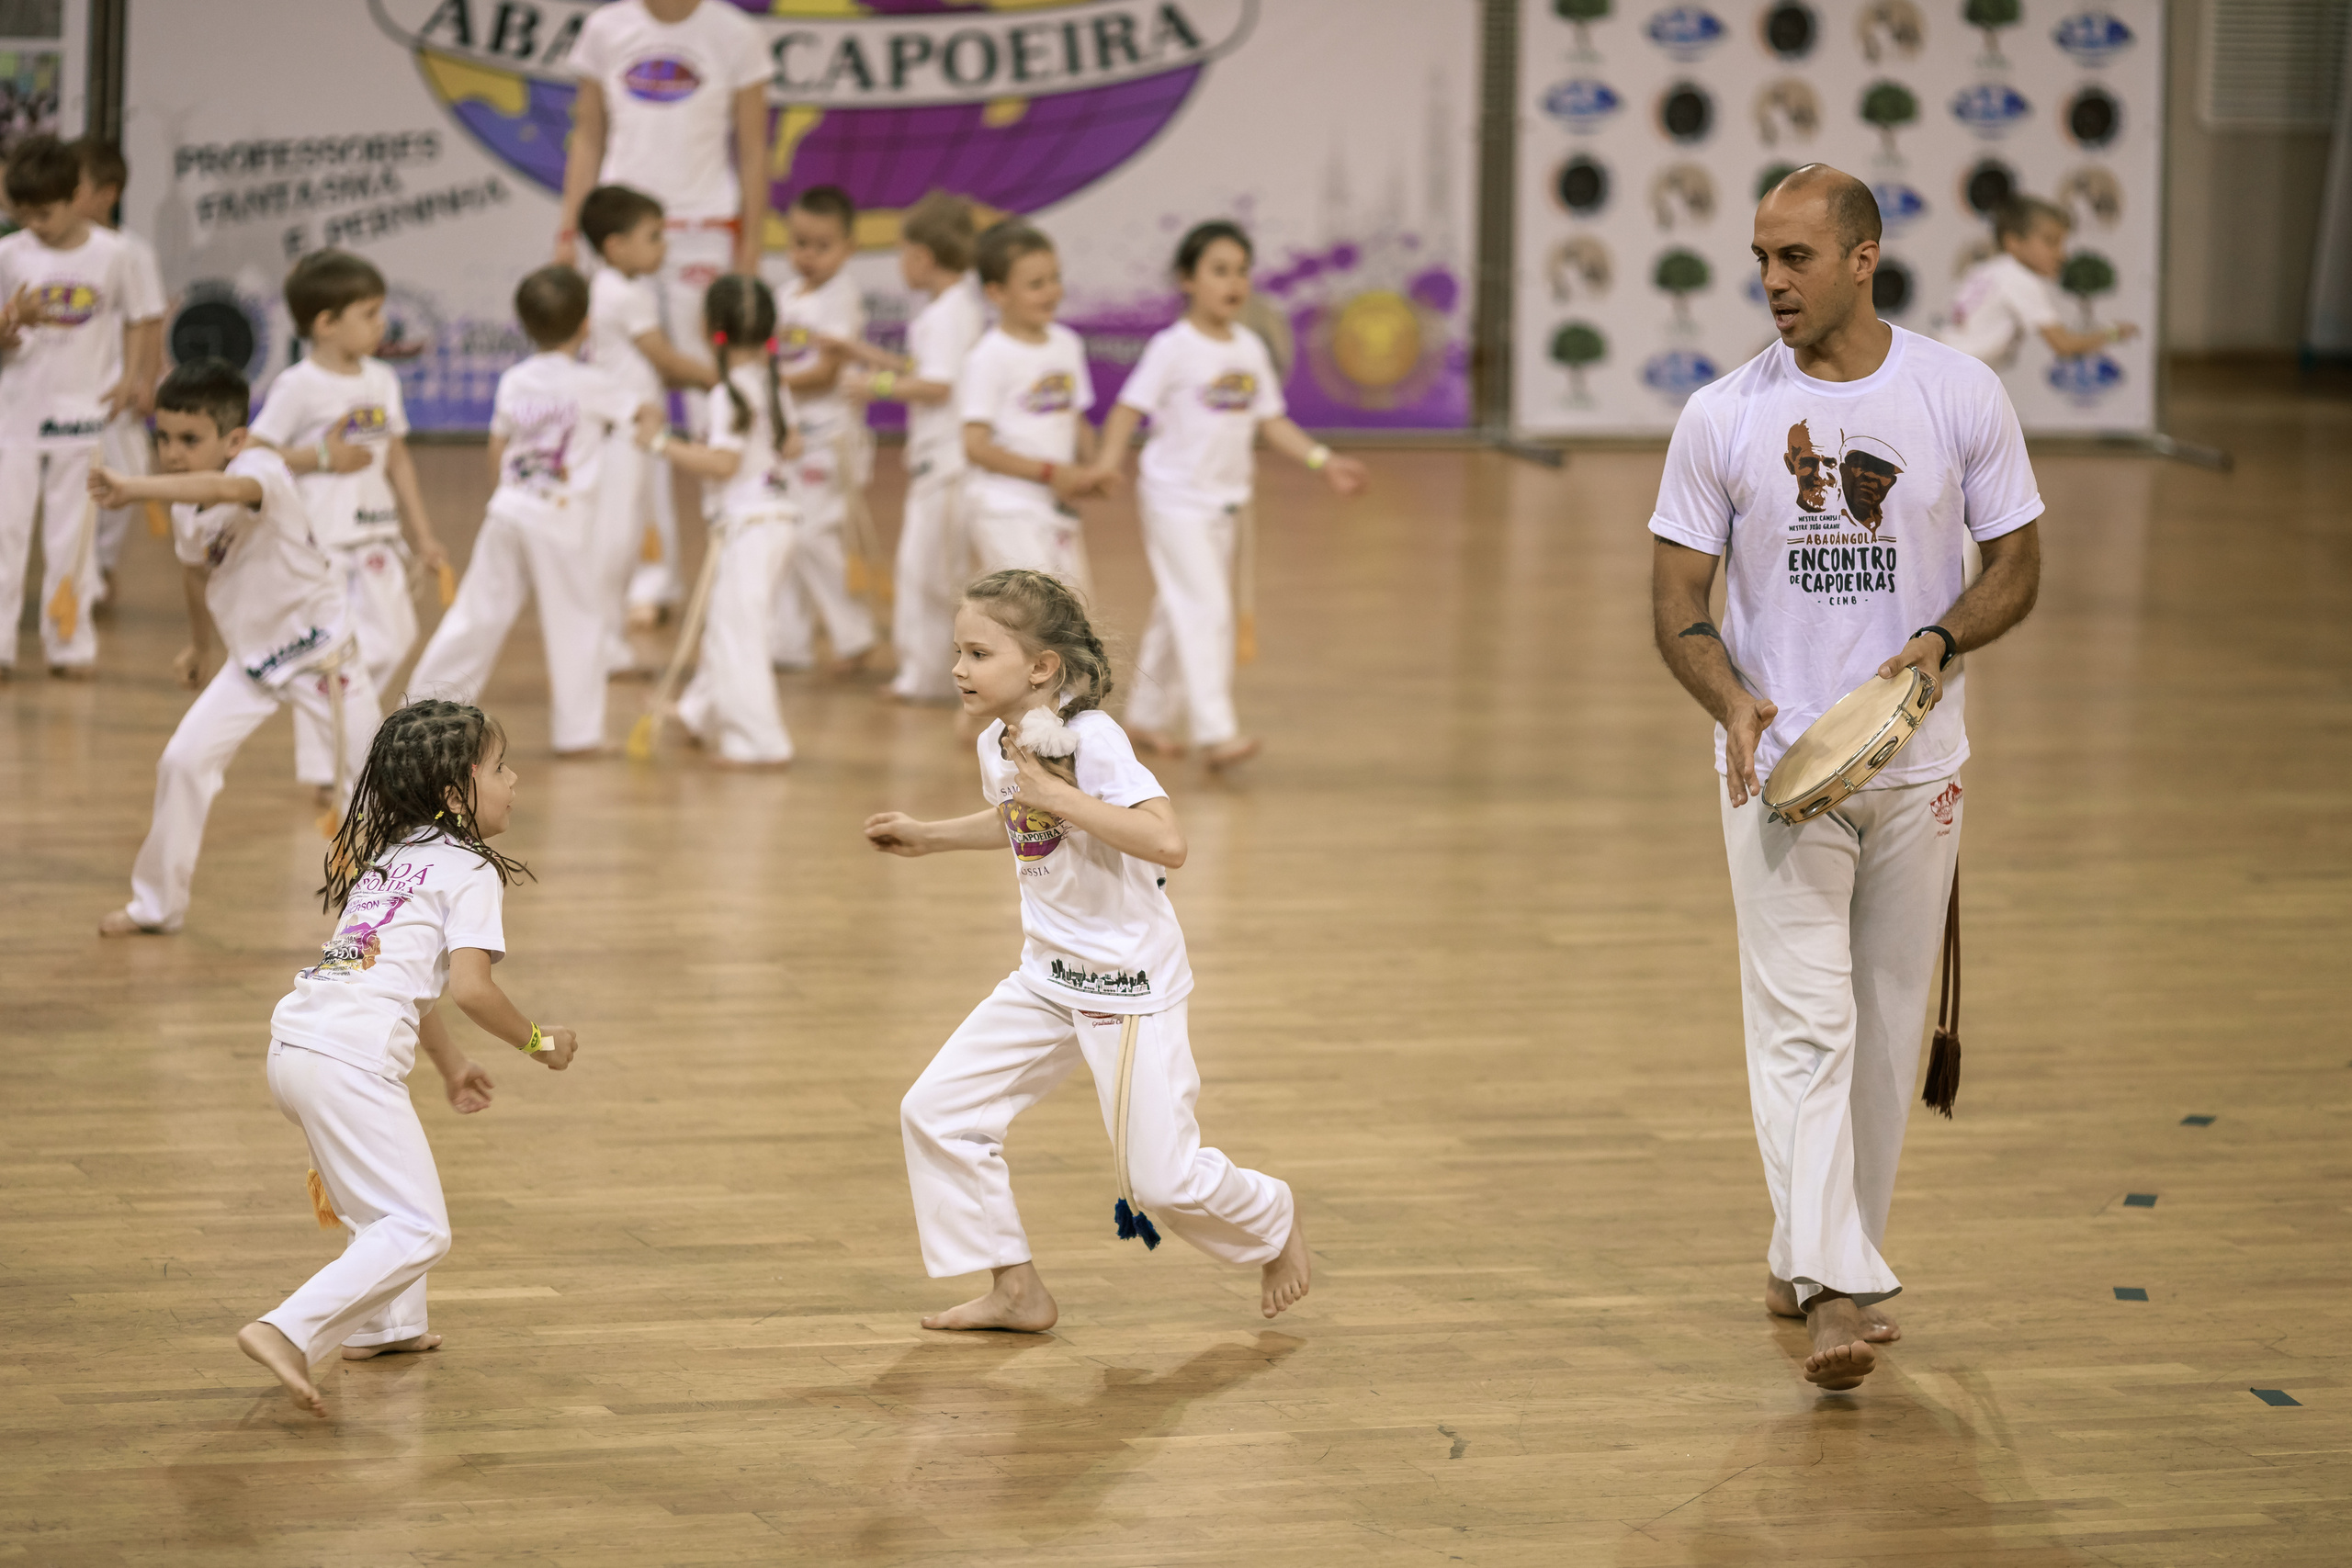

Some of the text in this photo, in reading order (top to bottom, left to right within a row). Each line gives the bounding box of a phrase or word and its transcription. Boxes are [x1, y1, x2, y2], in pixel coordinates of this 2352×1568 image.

[770, 2, 1203, 92] CAPOEIRA
[1806, 532, 1877, 545] ABADÁNGOLA
[1789, 547, 1896, 571] ENCONTRO
[1790, 572, 1895, 593] DE CAPOEIRAS
[1021, 866, 1049, 876] USSIA
